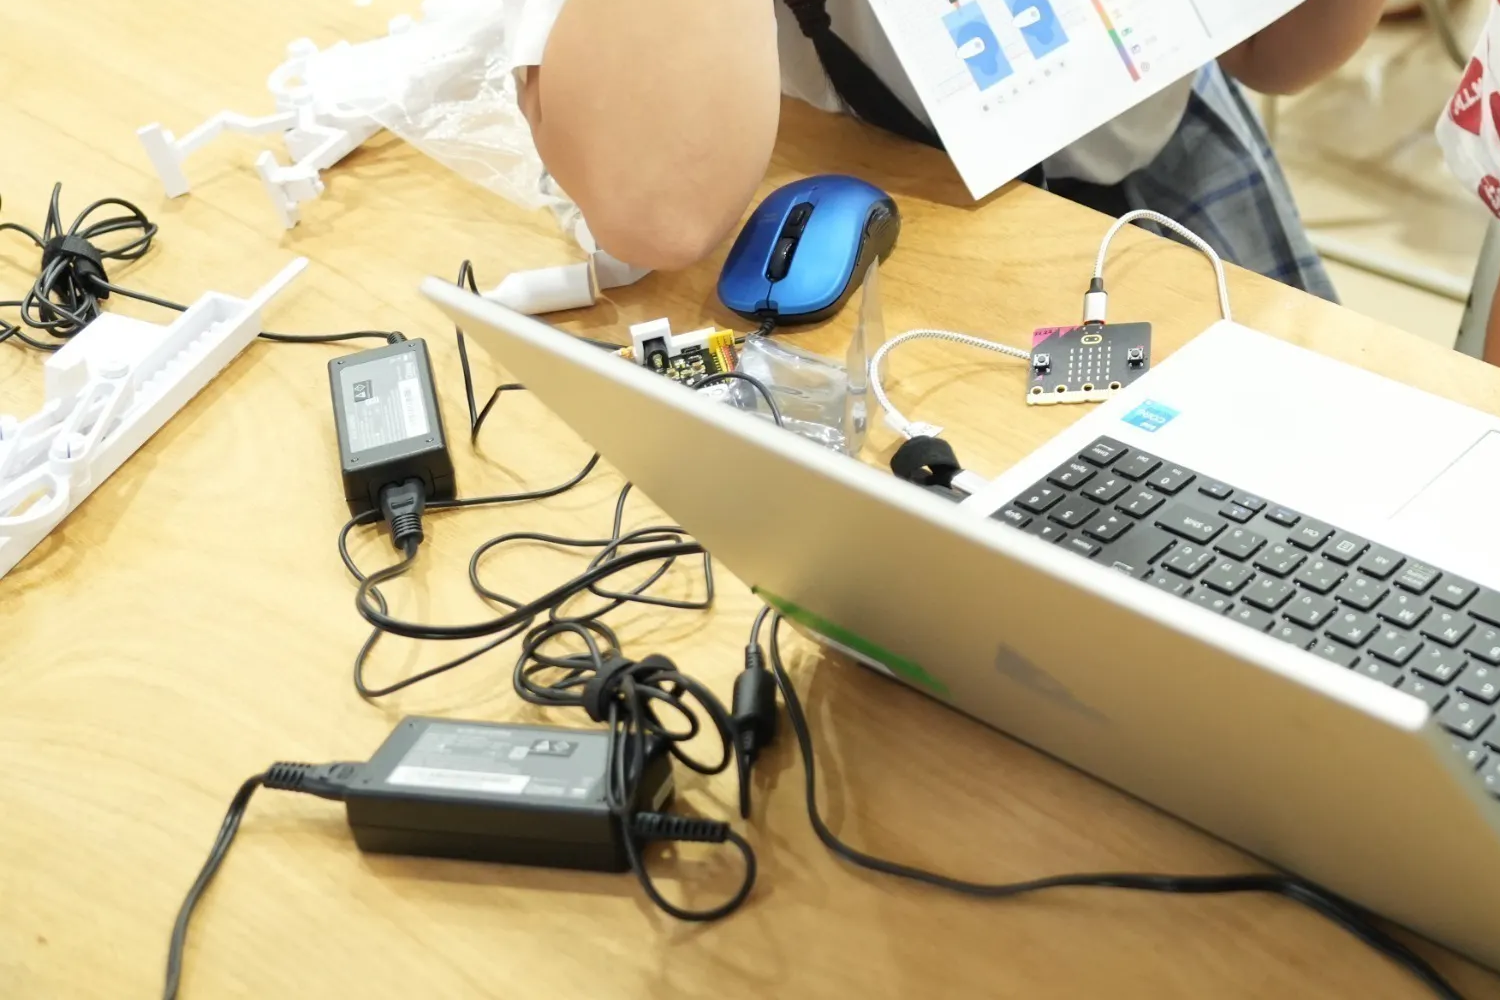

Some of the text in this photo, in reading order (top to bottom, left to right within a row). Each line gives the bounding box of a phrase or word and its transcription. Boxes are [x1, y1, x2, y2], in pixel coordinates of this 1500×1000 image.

[1091, 447, 1110, 457] Enter
[1136, 455, 1149, 463] Del
[1061, 472, 1071, 481] 3
[1094, 486, 1105, 494] 2
[1029, 496, 1039, 504] 6
[1129, 500, 1138, 509] 1
[1063, 510, 1073, 519] 5
[1097, 525, 1107, 533] 4
[1302, 527, 1319, 537] Ctrl
[1310, 610, 1320, 620] L
[1397, 609, 1415, 621] M
[1347, 628, 1362, 638] K
[1444, 627, 1457, 639] N
[1435, 664, 1451, 676] H
[1481, 683, 1494, 695] G
[1462, 719, 1475, 730] T
